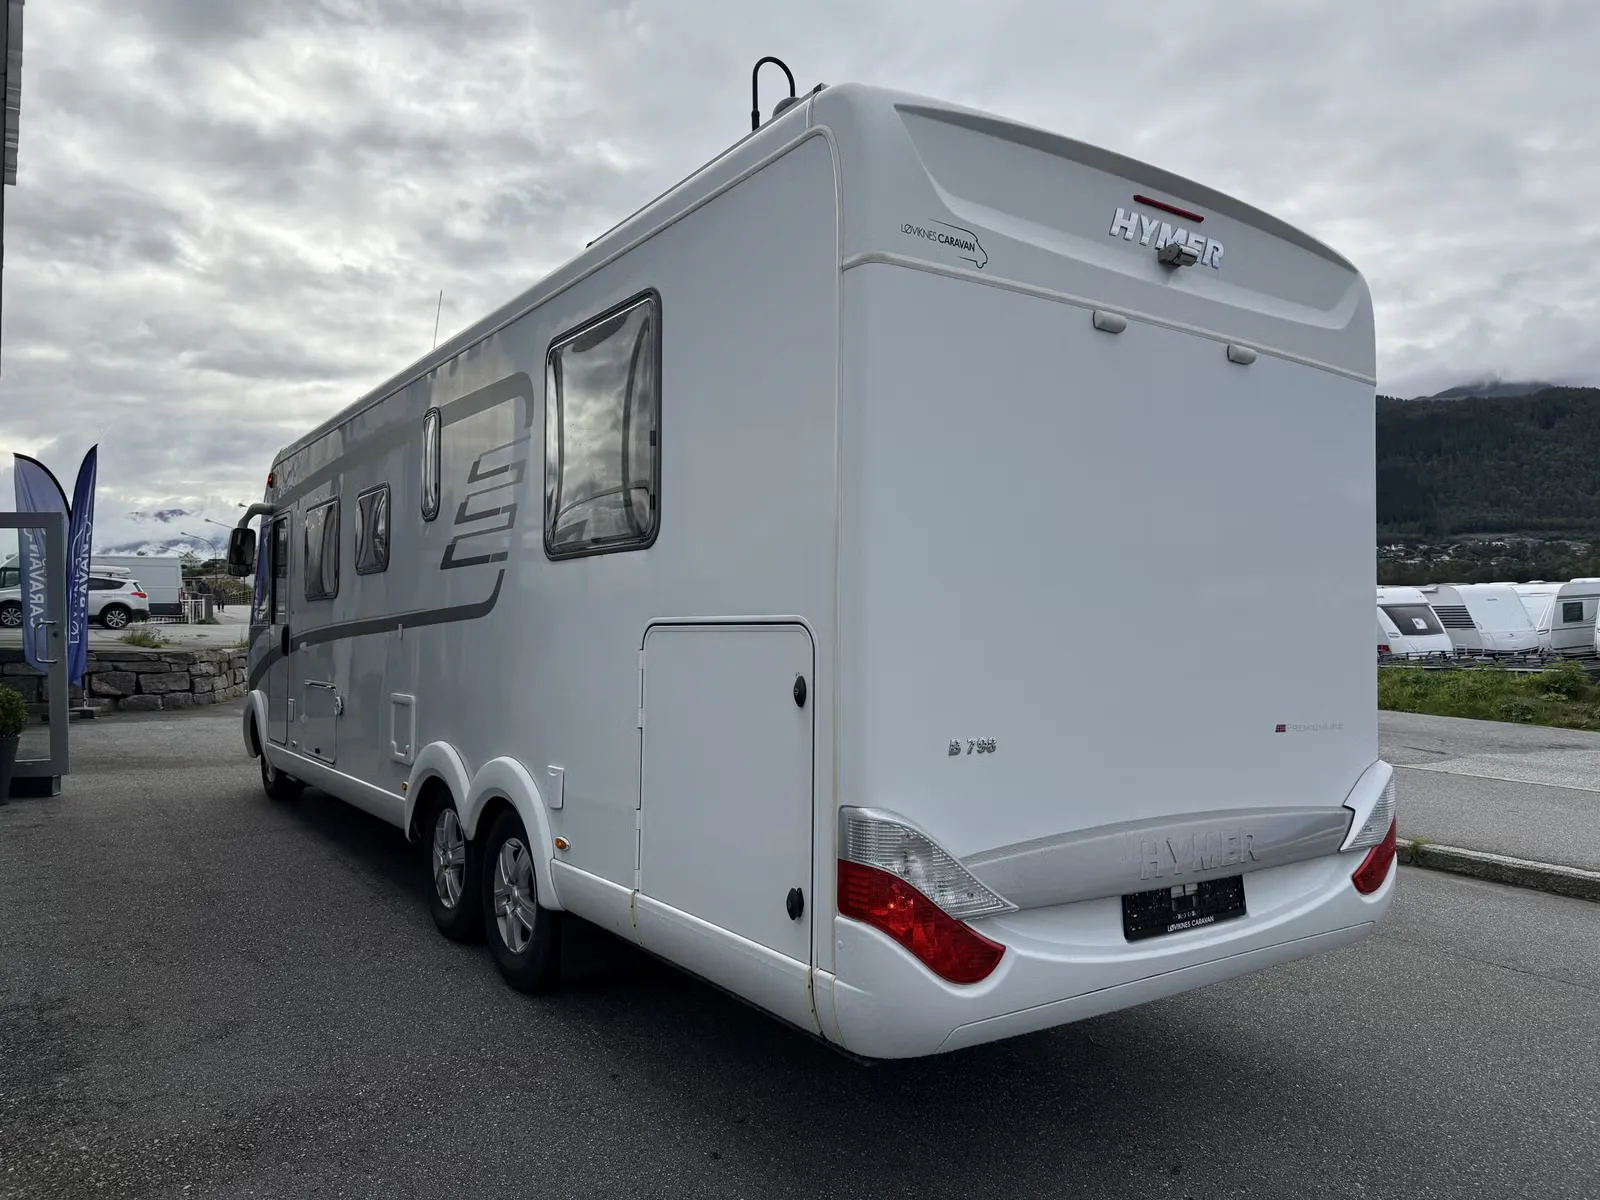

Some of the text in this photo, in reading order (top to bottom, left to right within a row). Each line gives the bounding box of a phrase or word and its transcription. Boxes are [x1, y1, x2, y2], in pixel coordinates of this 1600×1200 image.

[900, 223, 976, 252] LØVIKNES CARAVAN
[1109, 207, 1225, 269] HYMER
[948, 738, 962, 757] B
[1141, 826, 1261, 881] HYMER
[1191, 915, 1215, 927] CARAVAN
